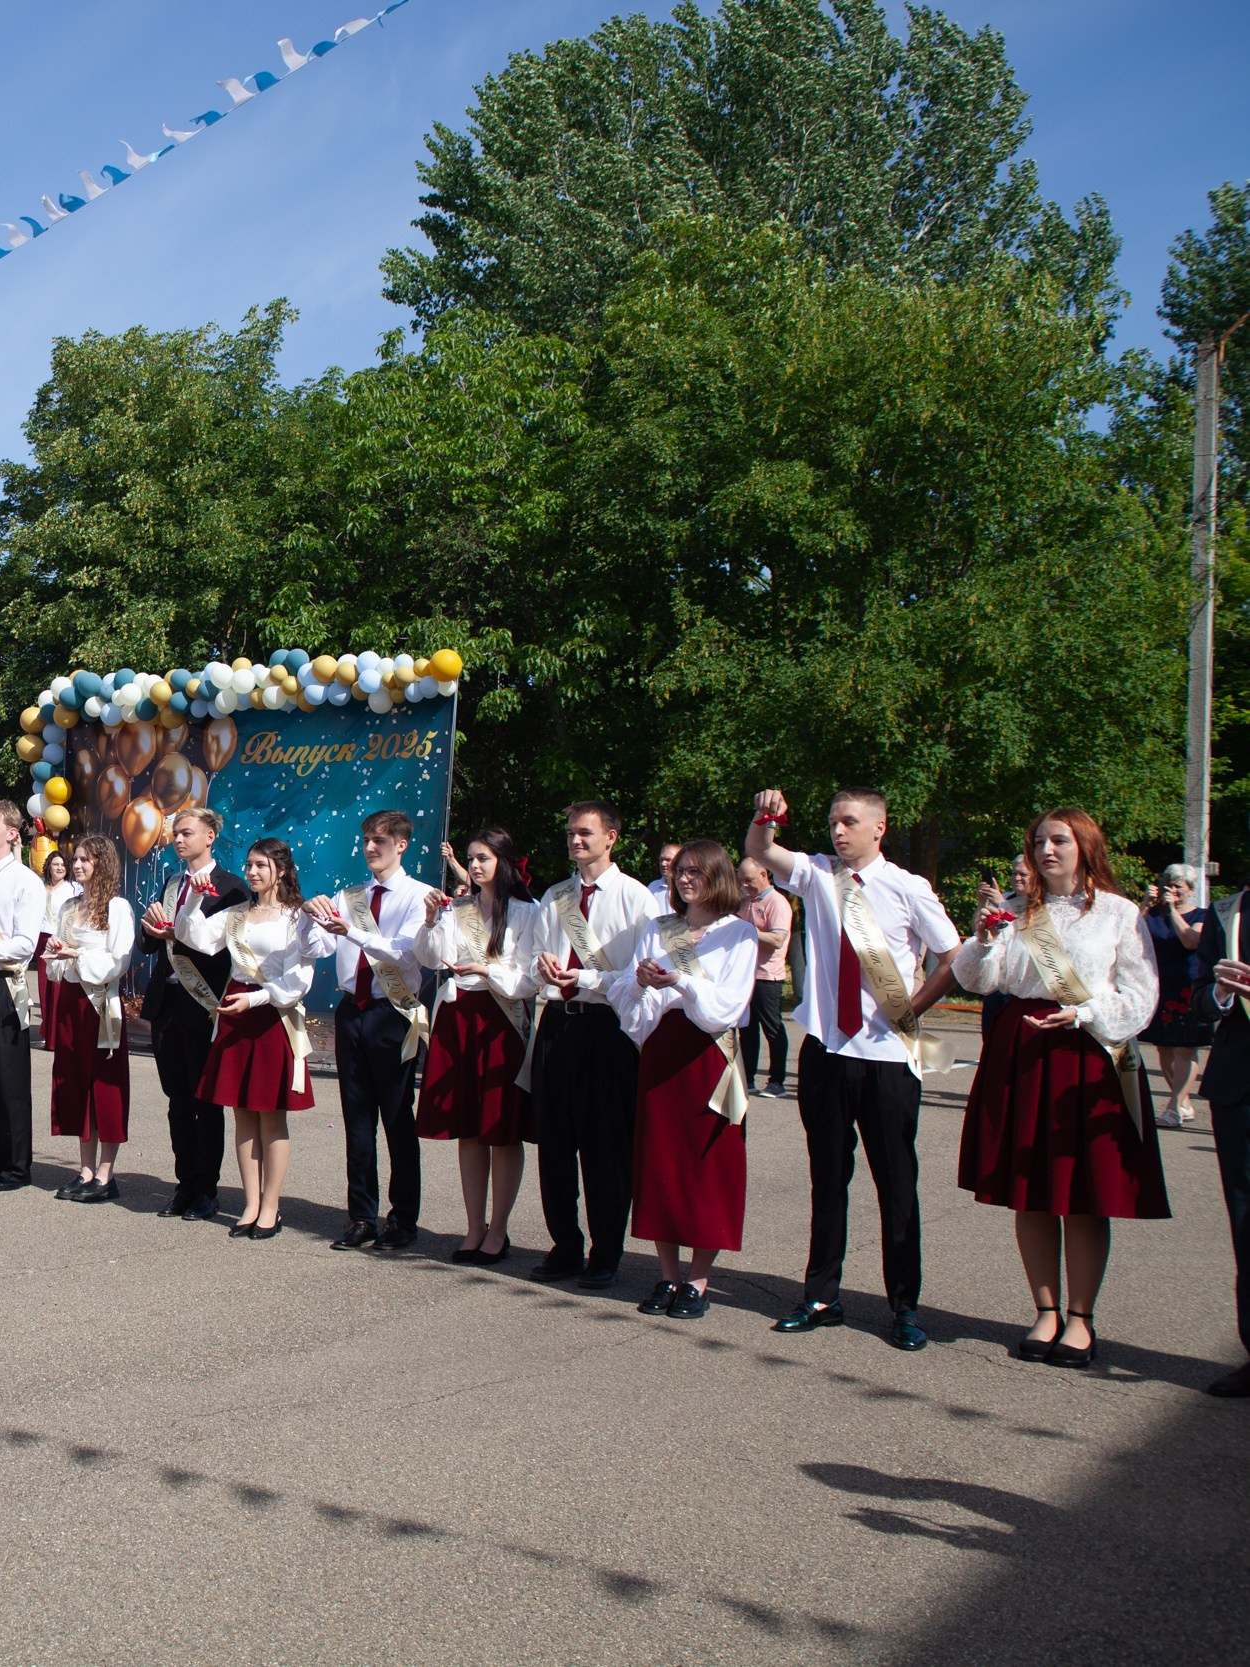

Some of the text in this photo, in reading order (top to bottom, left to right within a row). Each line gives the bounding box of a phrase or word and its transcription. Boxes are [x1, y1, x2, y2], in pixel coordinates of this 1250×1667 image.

[240, 730, 439, 777] Выпуск 2025
[567, 914, 603, 972] Выпускни
[877, 974, 907, 1008] 2025
